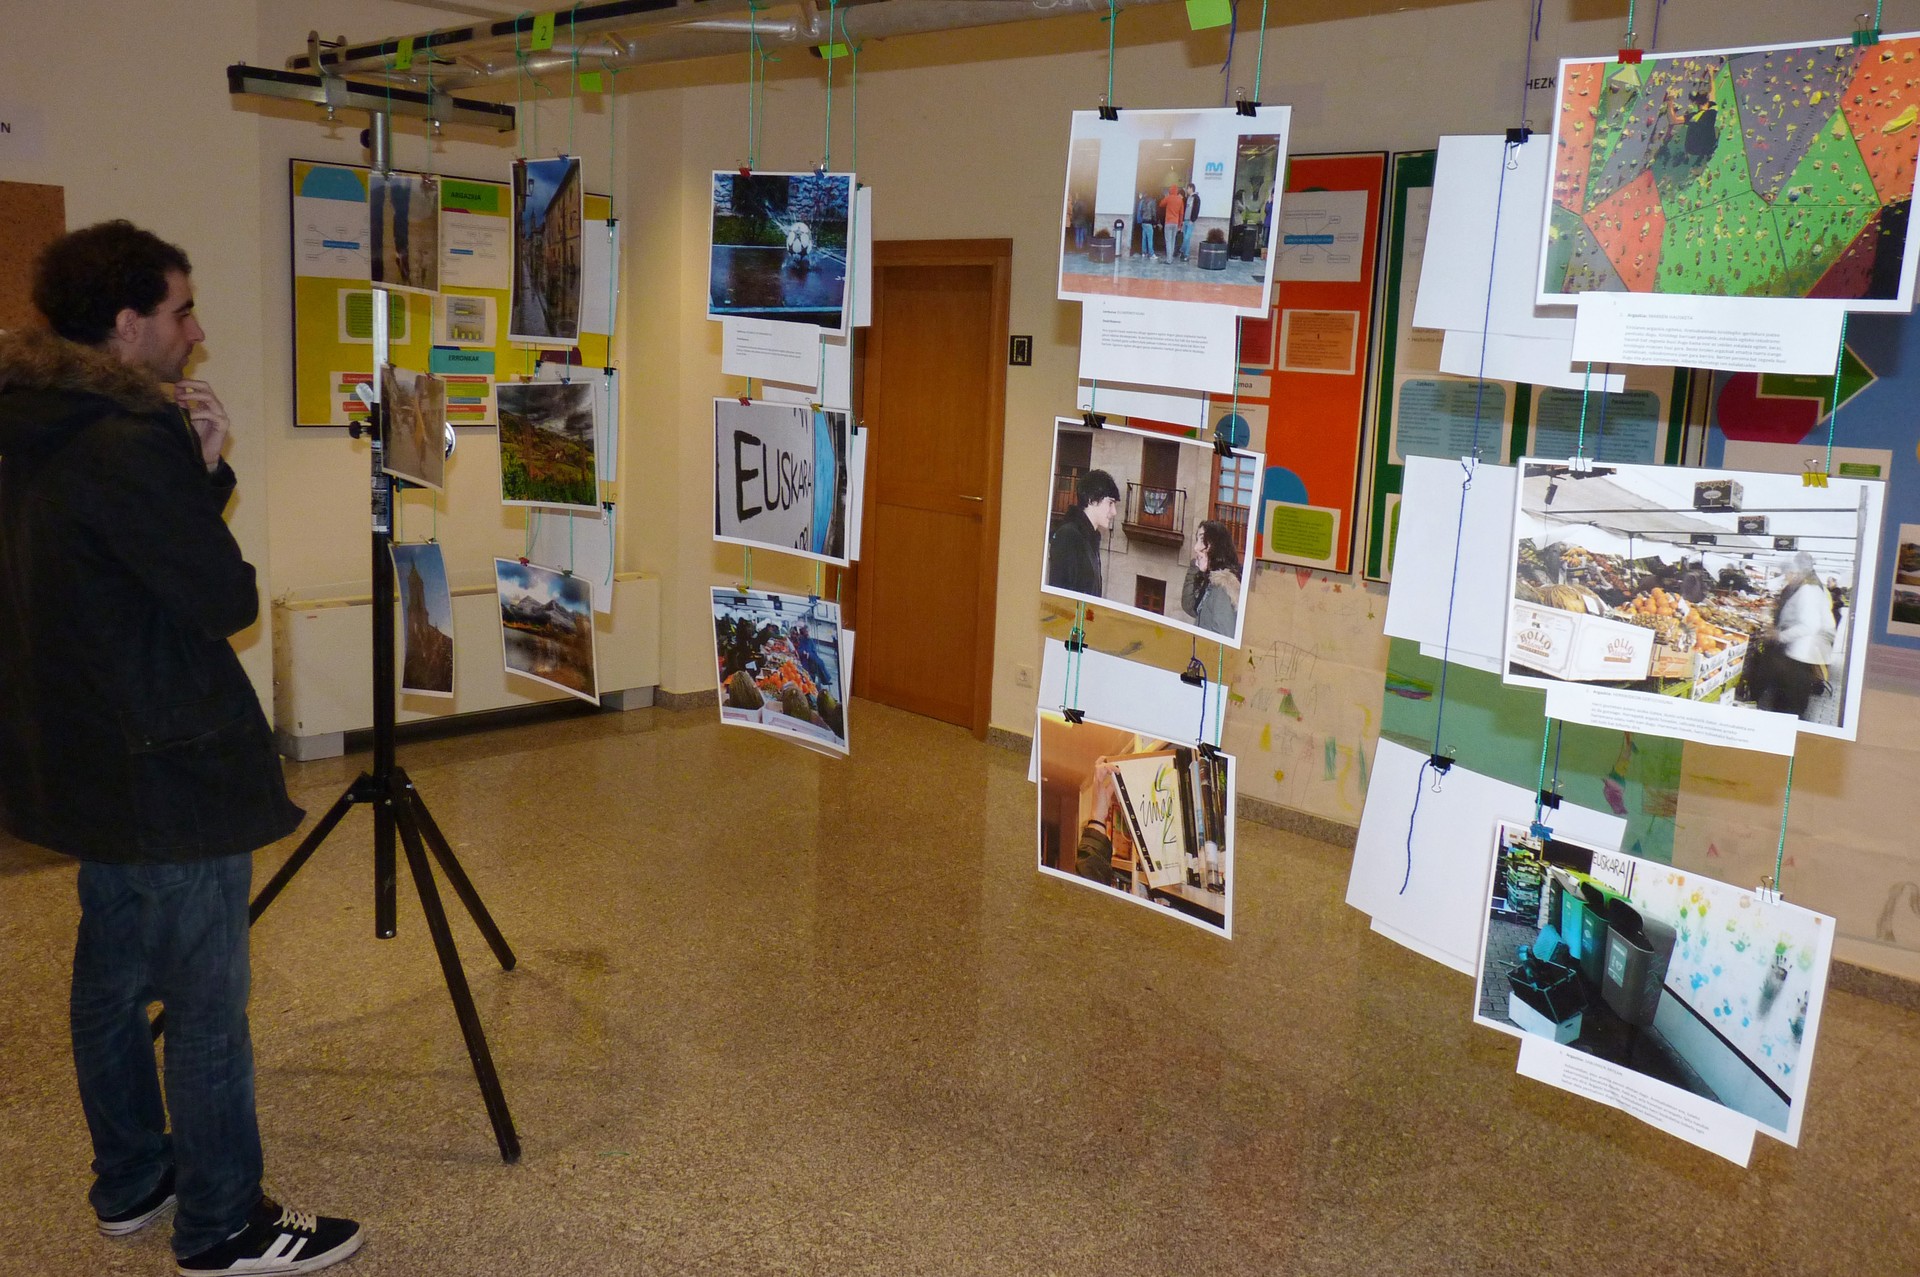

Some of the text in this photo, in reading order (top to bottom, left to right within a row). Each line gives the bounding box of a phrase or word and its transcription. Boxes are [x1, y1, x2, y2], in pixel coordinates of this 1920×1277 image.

[540, 25, 547, 41] 2
[1, 122, 11, 134] N
[1593, 851, 1626, 878] EUSKARA
